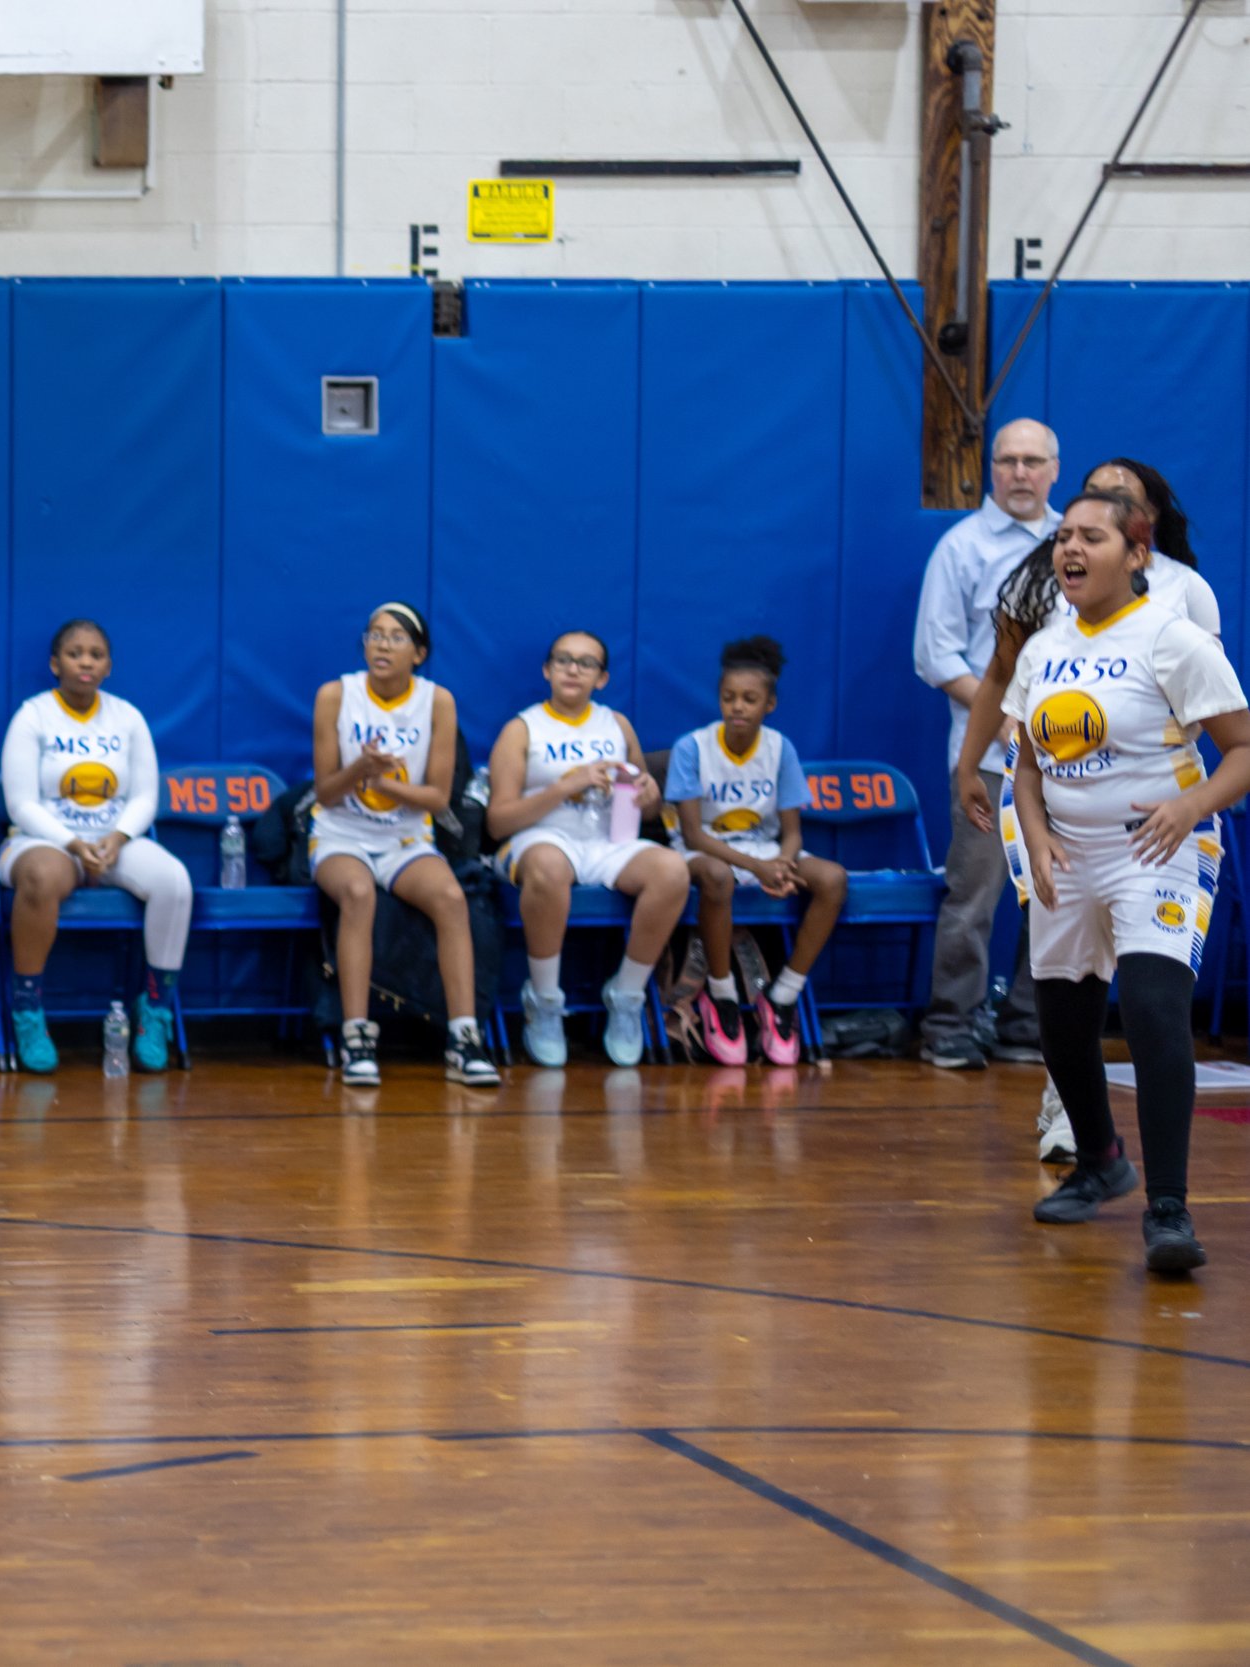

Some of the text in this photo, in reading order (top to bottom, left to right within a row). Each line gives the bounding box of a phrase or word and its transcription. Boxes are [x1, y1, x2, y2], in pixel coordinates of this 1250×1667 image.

[410, 224, 439, 278] E
[1037, 657, 1128, 687] MS 50
[50, 735, 121, 757] MS 50
[395, 727, 420, 750] 50
[543, 740, 615, 763] MS 50
[167, 775, 270, 813] MS 50
[705, 778, 774, 804] MS 50
[851, 773, 895, 809] 50
